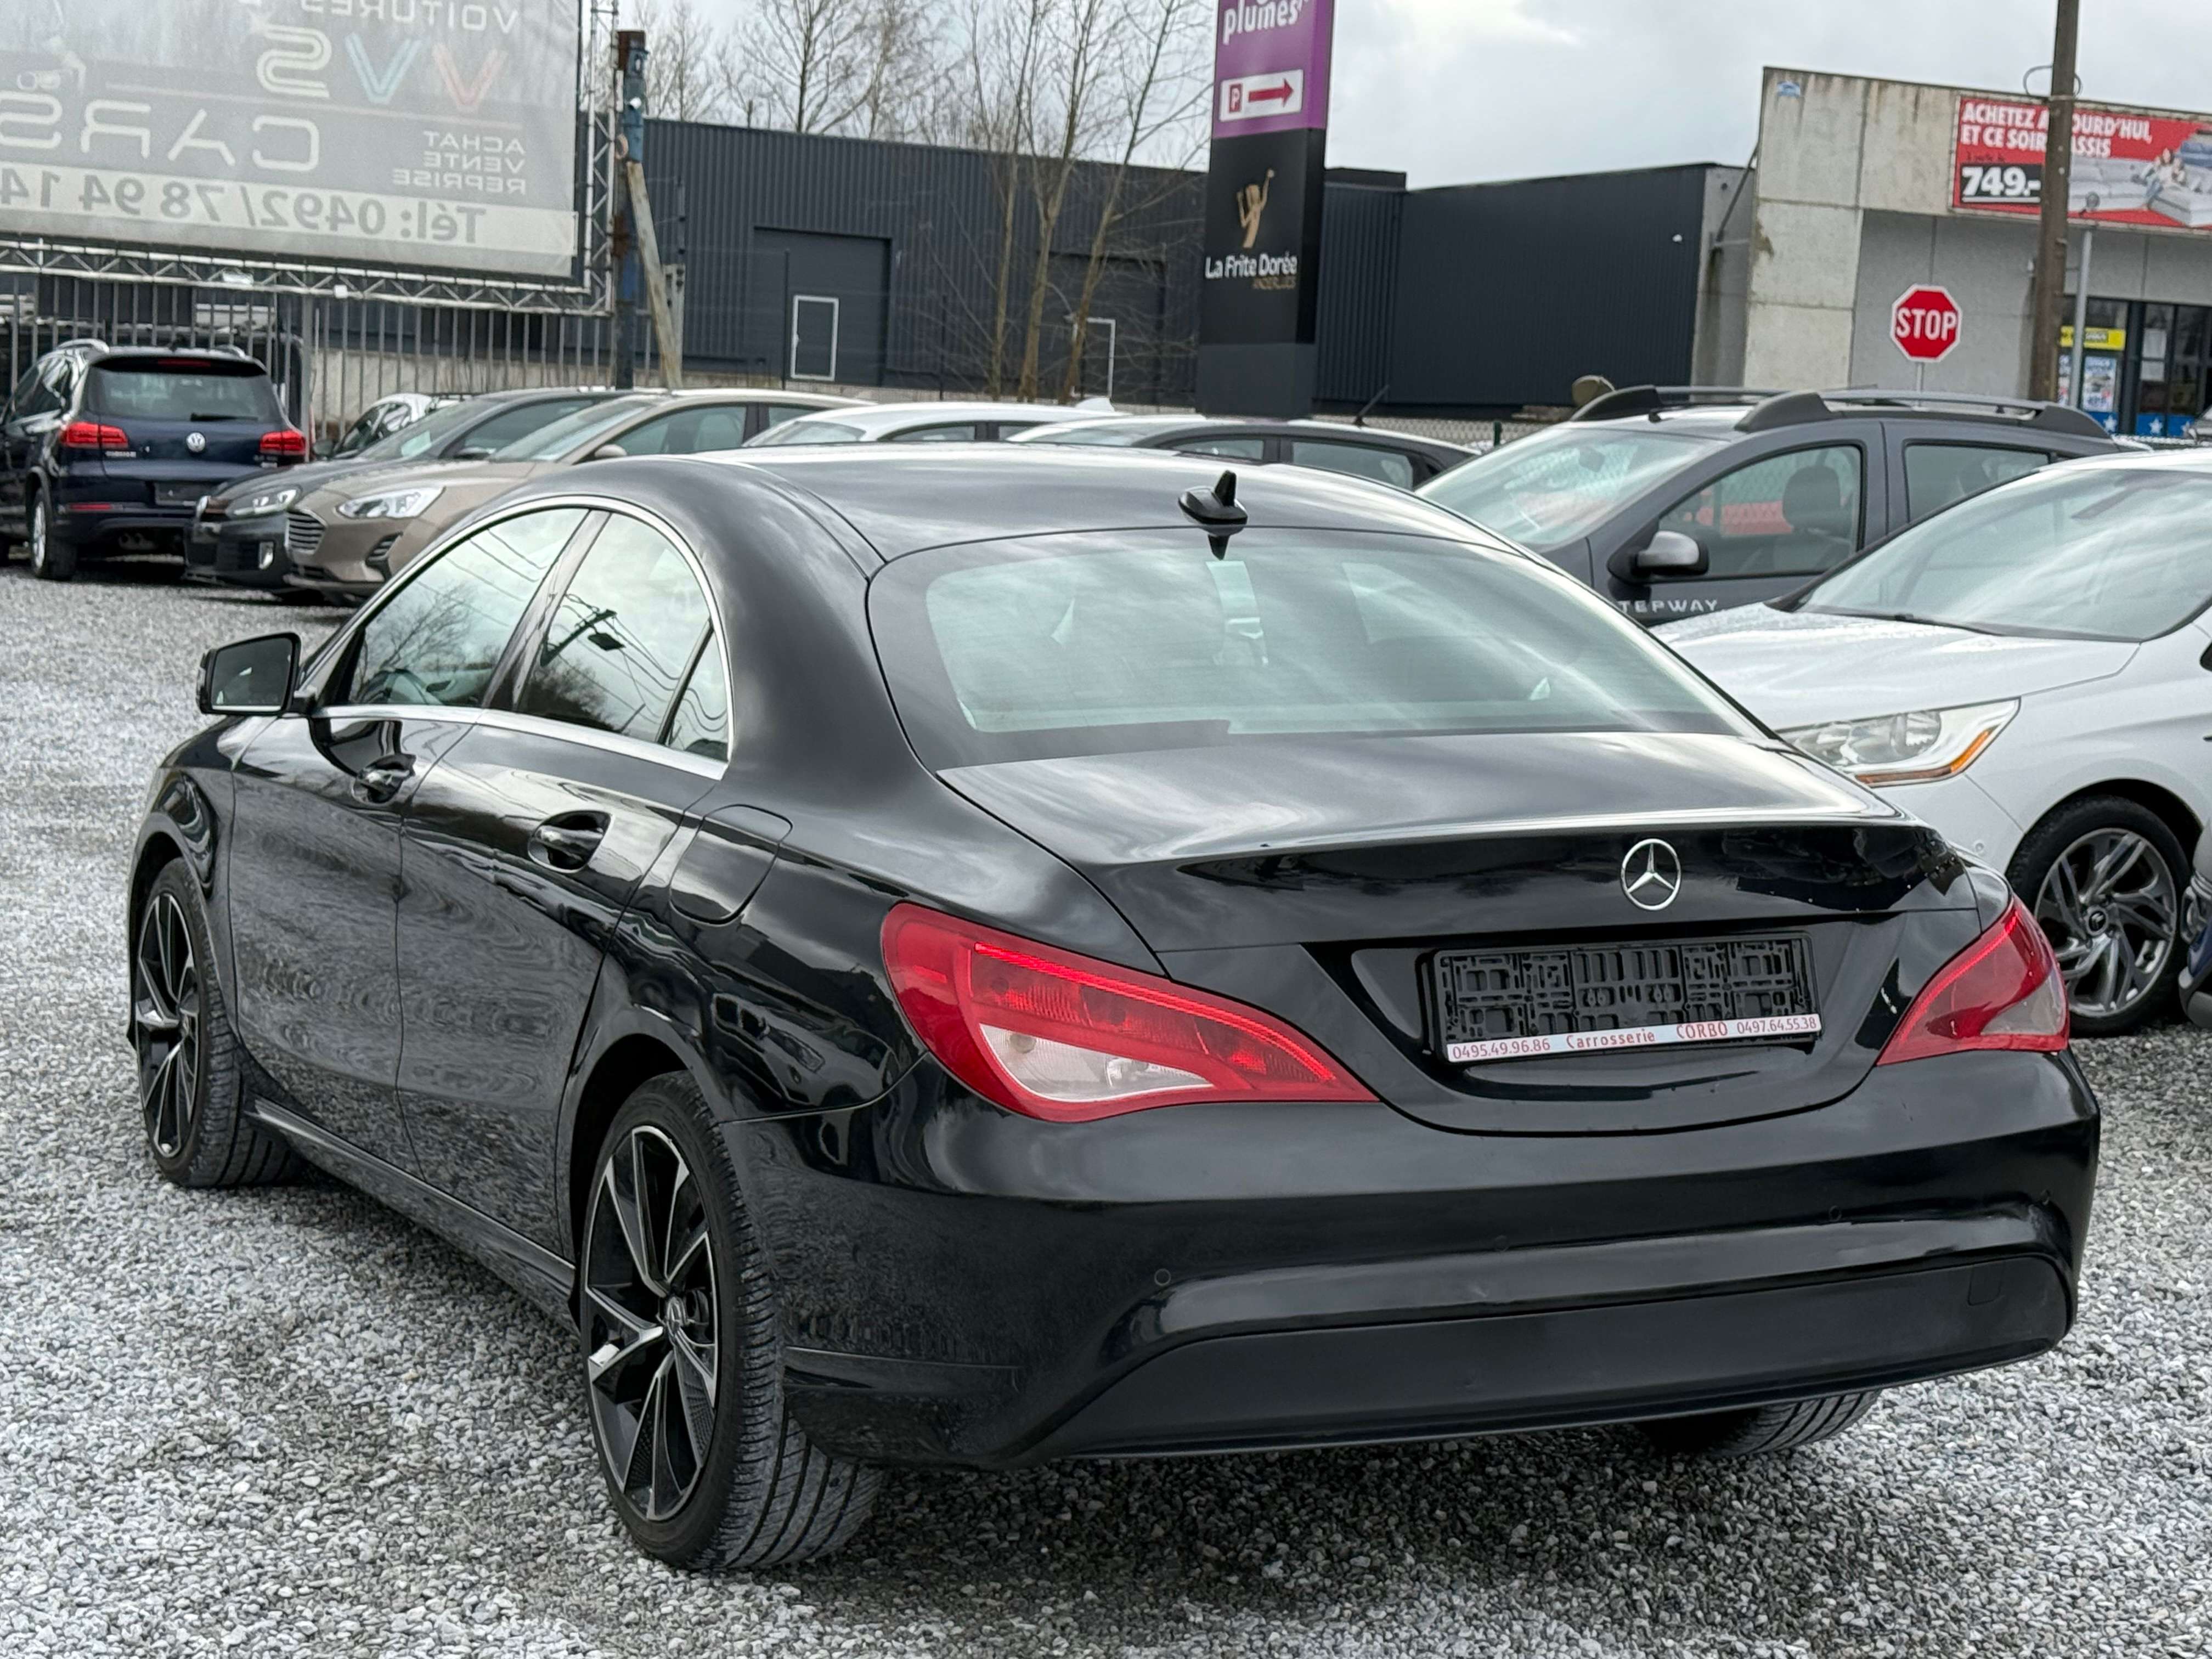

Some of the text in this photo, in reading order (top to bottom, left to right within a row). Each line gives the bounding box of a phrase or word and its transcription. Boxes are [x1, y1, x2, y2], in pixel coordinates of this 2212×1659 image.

[1961, 102, 2036, 129] ACHETEZ
[1960, 124, 1982, 145] ET
[1982, 126, 2006, 149] CE
[1205, 256, 1223, 279] La
[1224, 254, 1257, 278] Frite
[1896, 307, 1957, 341] STOP
[1453, 1017, 1817, 1059] 0495.49.96.86 Carrosserie CORBO 0497.64.55.38
